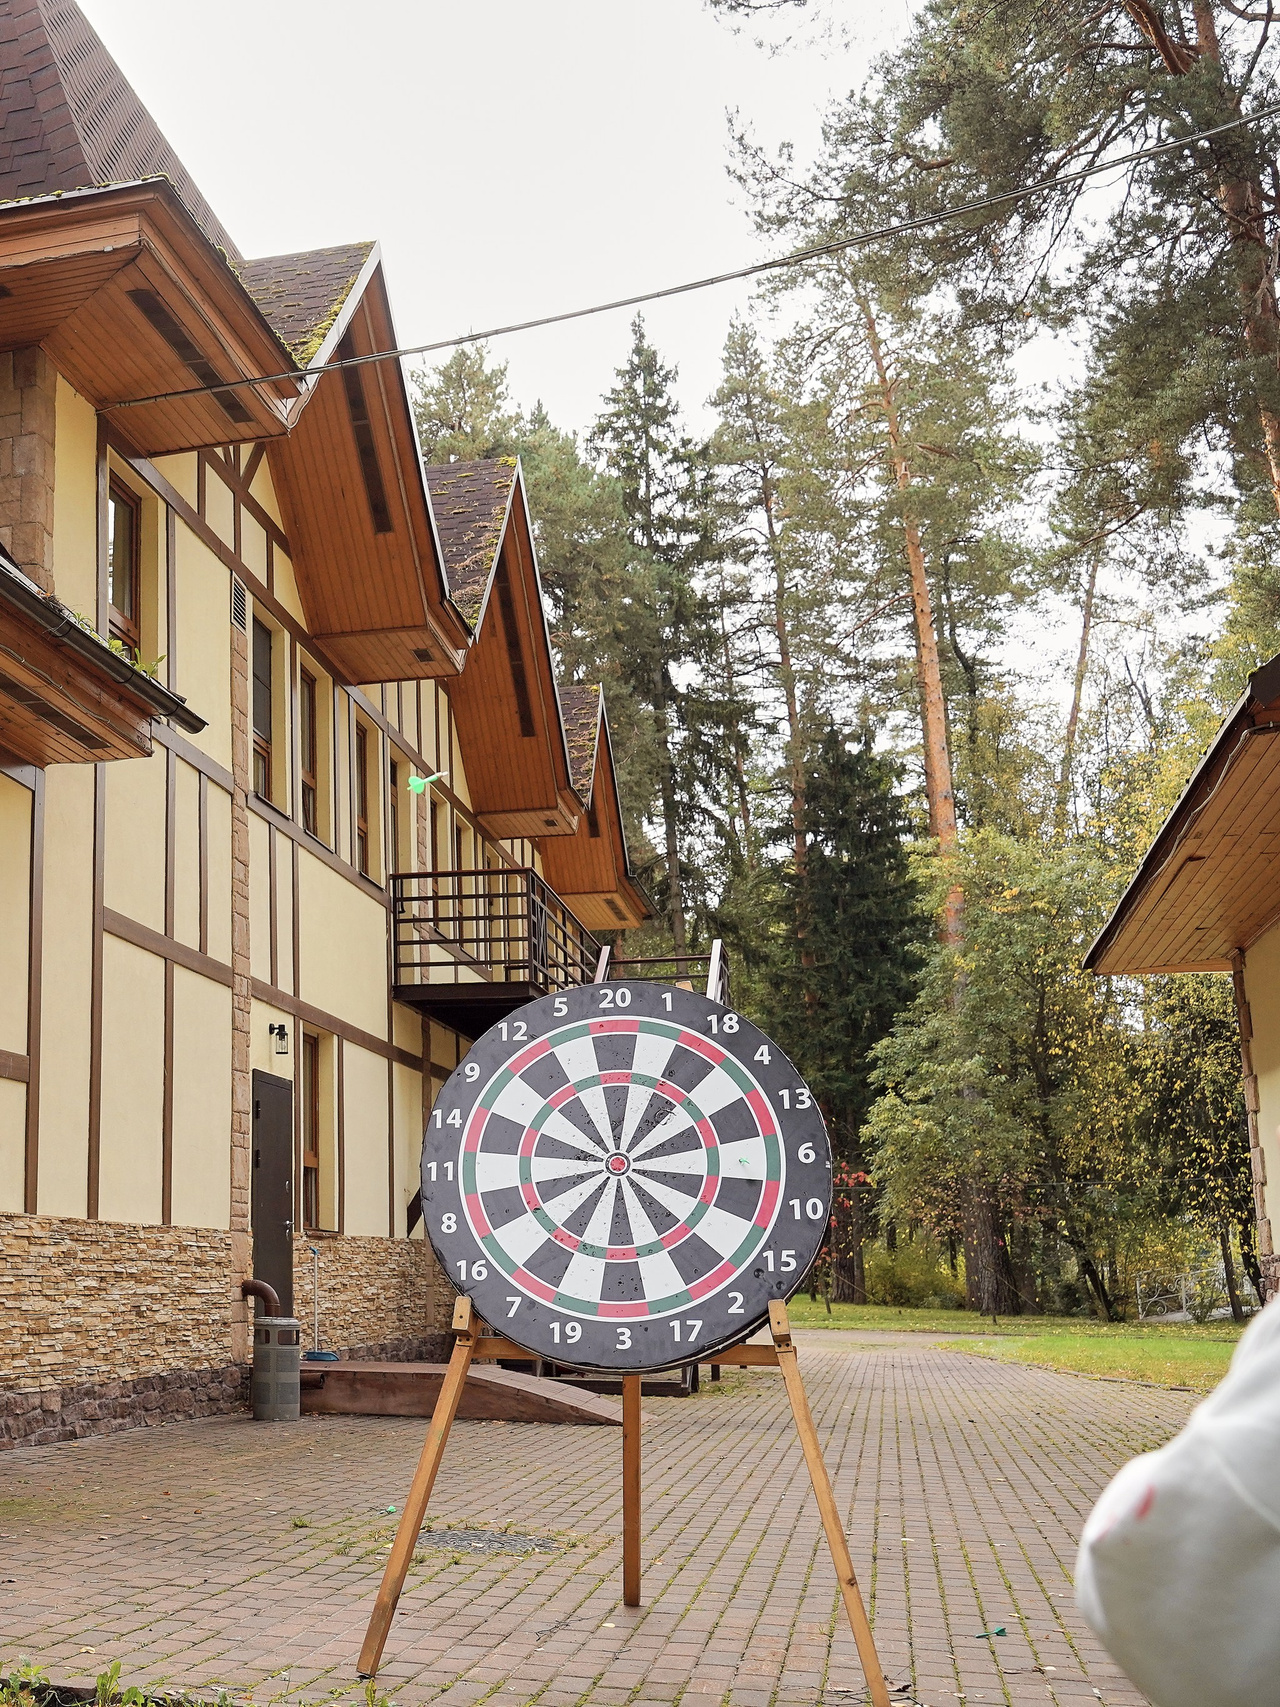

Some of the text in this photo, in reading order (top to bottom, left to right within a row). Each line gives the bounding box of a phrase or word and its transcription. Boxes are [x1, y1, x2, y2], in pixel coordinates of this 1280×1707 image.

[553, 998, 568, 1017] 5
[599, 988, 631, 1008] 20
[662, 993, 673, 1012] 1
[498, 1021, 528, 1042] 12
[707, 1014, 740, 1035] 18
[754, 1045, 771, 1065] 4
[464, 1063, 480, 1082] 9
[778, 1089, 811, 1110] 13
[432, 1109, 462, 1128] 14
[798, 1142, 816, 1164] 6
[427, 1161, 454, 1182] 11
[789, 1198, 823, 1220] 10
[441, 1213, 458, 1233] 8
[457, 1260, 488, 1281] 16
[763, 1250, 796, 1271] 15
[506, 1297, 522, 1318] 7
[728, 1292, 745, 1313] 2
[549, 1322, 582, 1343] 19
[616, 1328, 632, 1350] 3
[669, 1320, 703, 1341] 17
